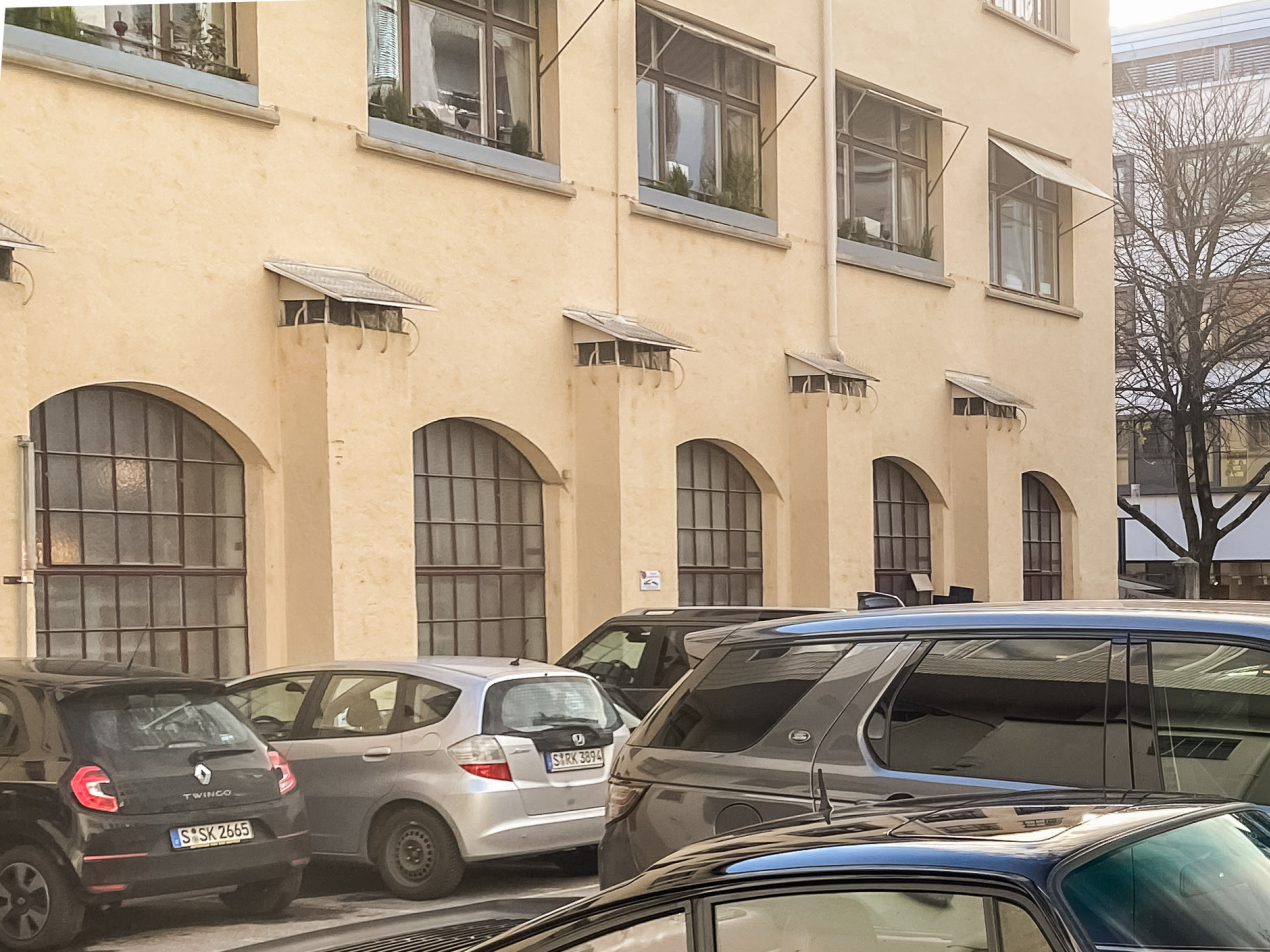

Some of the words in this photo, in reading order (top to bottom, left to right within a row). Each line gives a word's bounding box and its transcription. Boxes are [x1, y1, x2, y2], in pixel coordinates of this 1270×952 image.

[181, 829, 191, 844] S
[198, 826, 217, 842] SK
[218, 822, 250, 840] 2665
